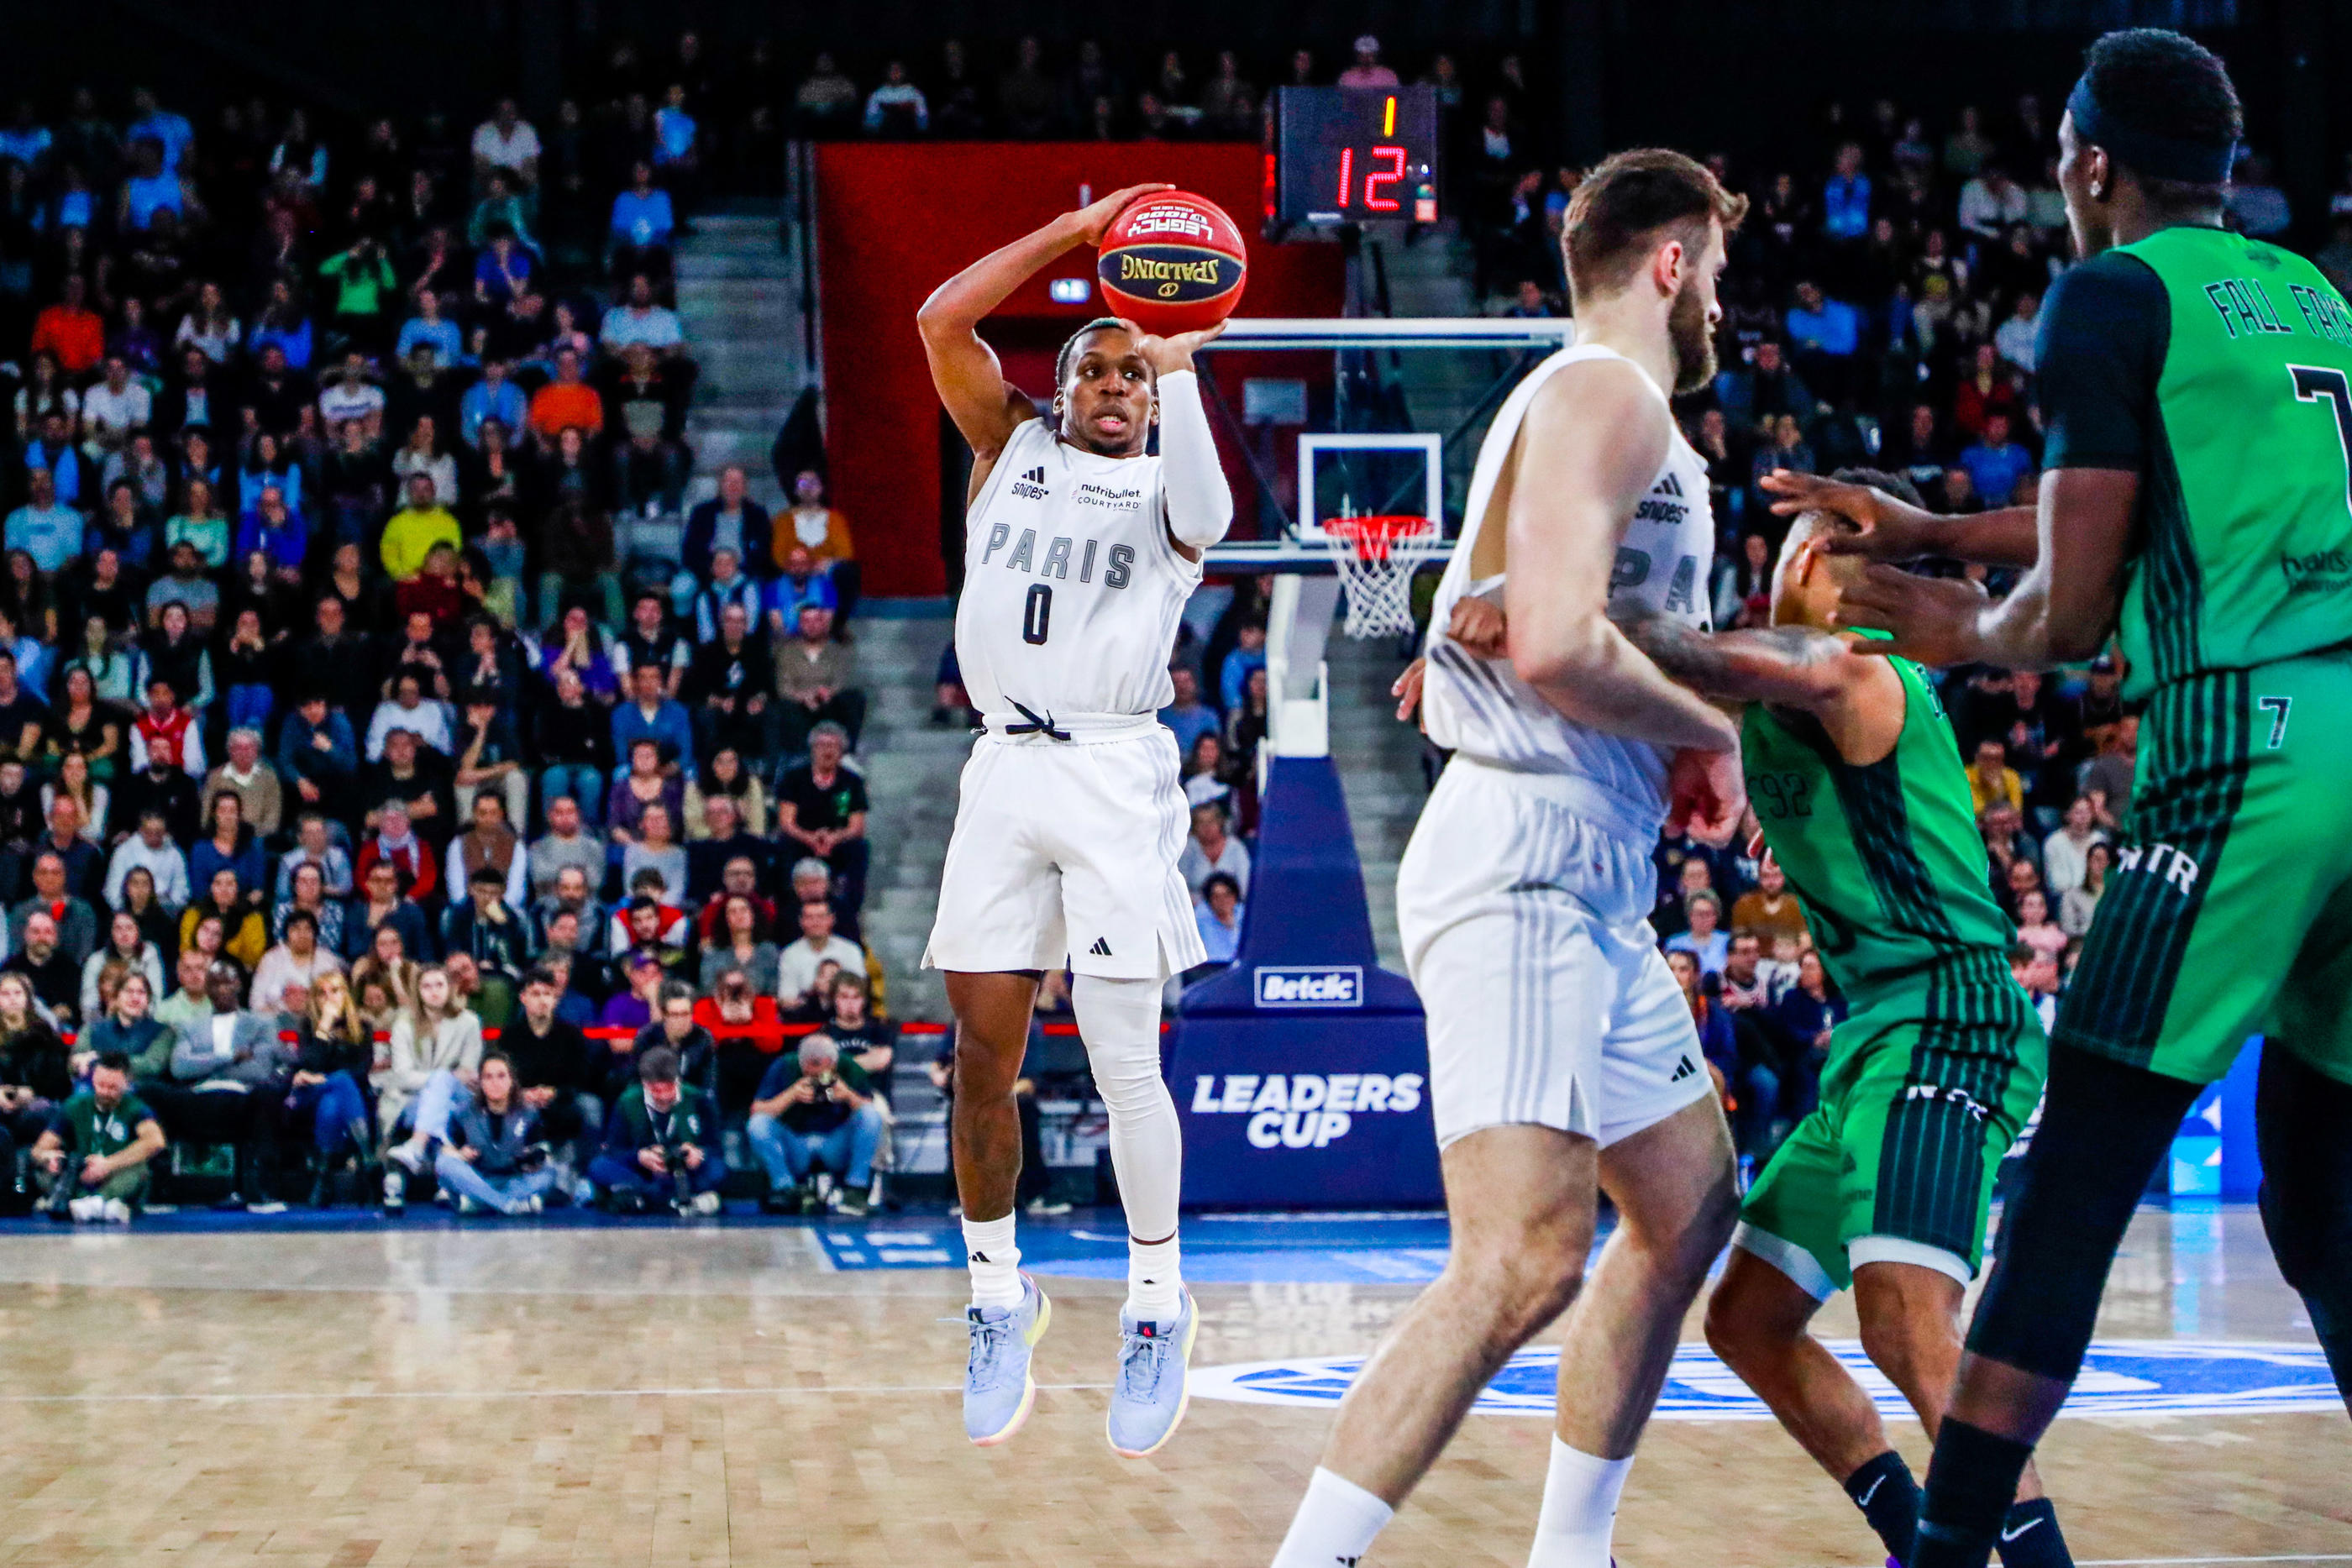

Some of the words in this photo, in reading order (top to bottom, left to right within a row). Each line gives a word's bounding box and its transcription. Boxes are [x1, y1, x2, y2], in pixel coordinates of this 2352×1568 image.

[1384, 95, 1396, 137] 1
[1338, 146, 1407, 211] 12
[1127, 218, 1214, 240] LEGACY
[1121, 254, 1218, 284] SPALDING
[2203, 278, 2294, 338] FALL
[2285, 363, 2352, 521] 7
[1011, 482, 1044, 500] snipes
[1078, 496, 1140, 509] COURTYARD
[1635, 501, 1684, 525] snipes
[981, 522, 1135, 590] PARIS
[1022, 583, 1053, 645] 0
[2260, 696, 2292, 749] 7
[1746, 772, 1813, 821] 92
[1263, 973, 1355, 1000] Betclic
[1191, 1072, 1424, 1113] LEADERS
[1247, 1110, 1352, 1148] CUP
